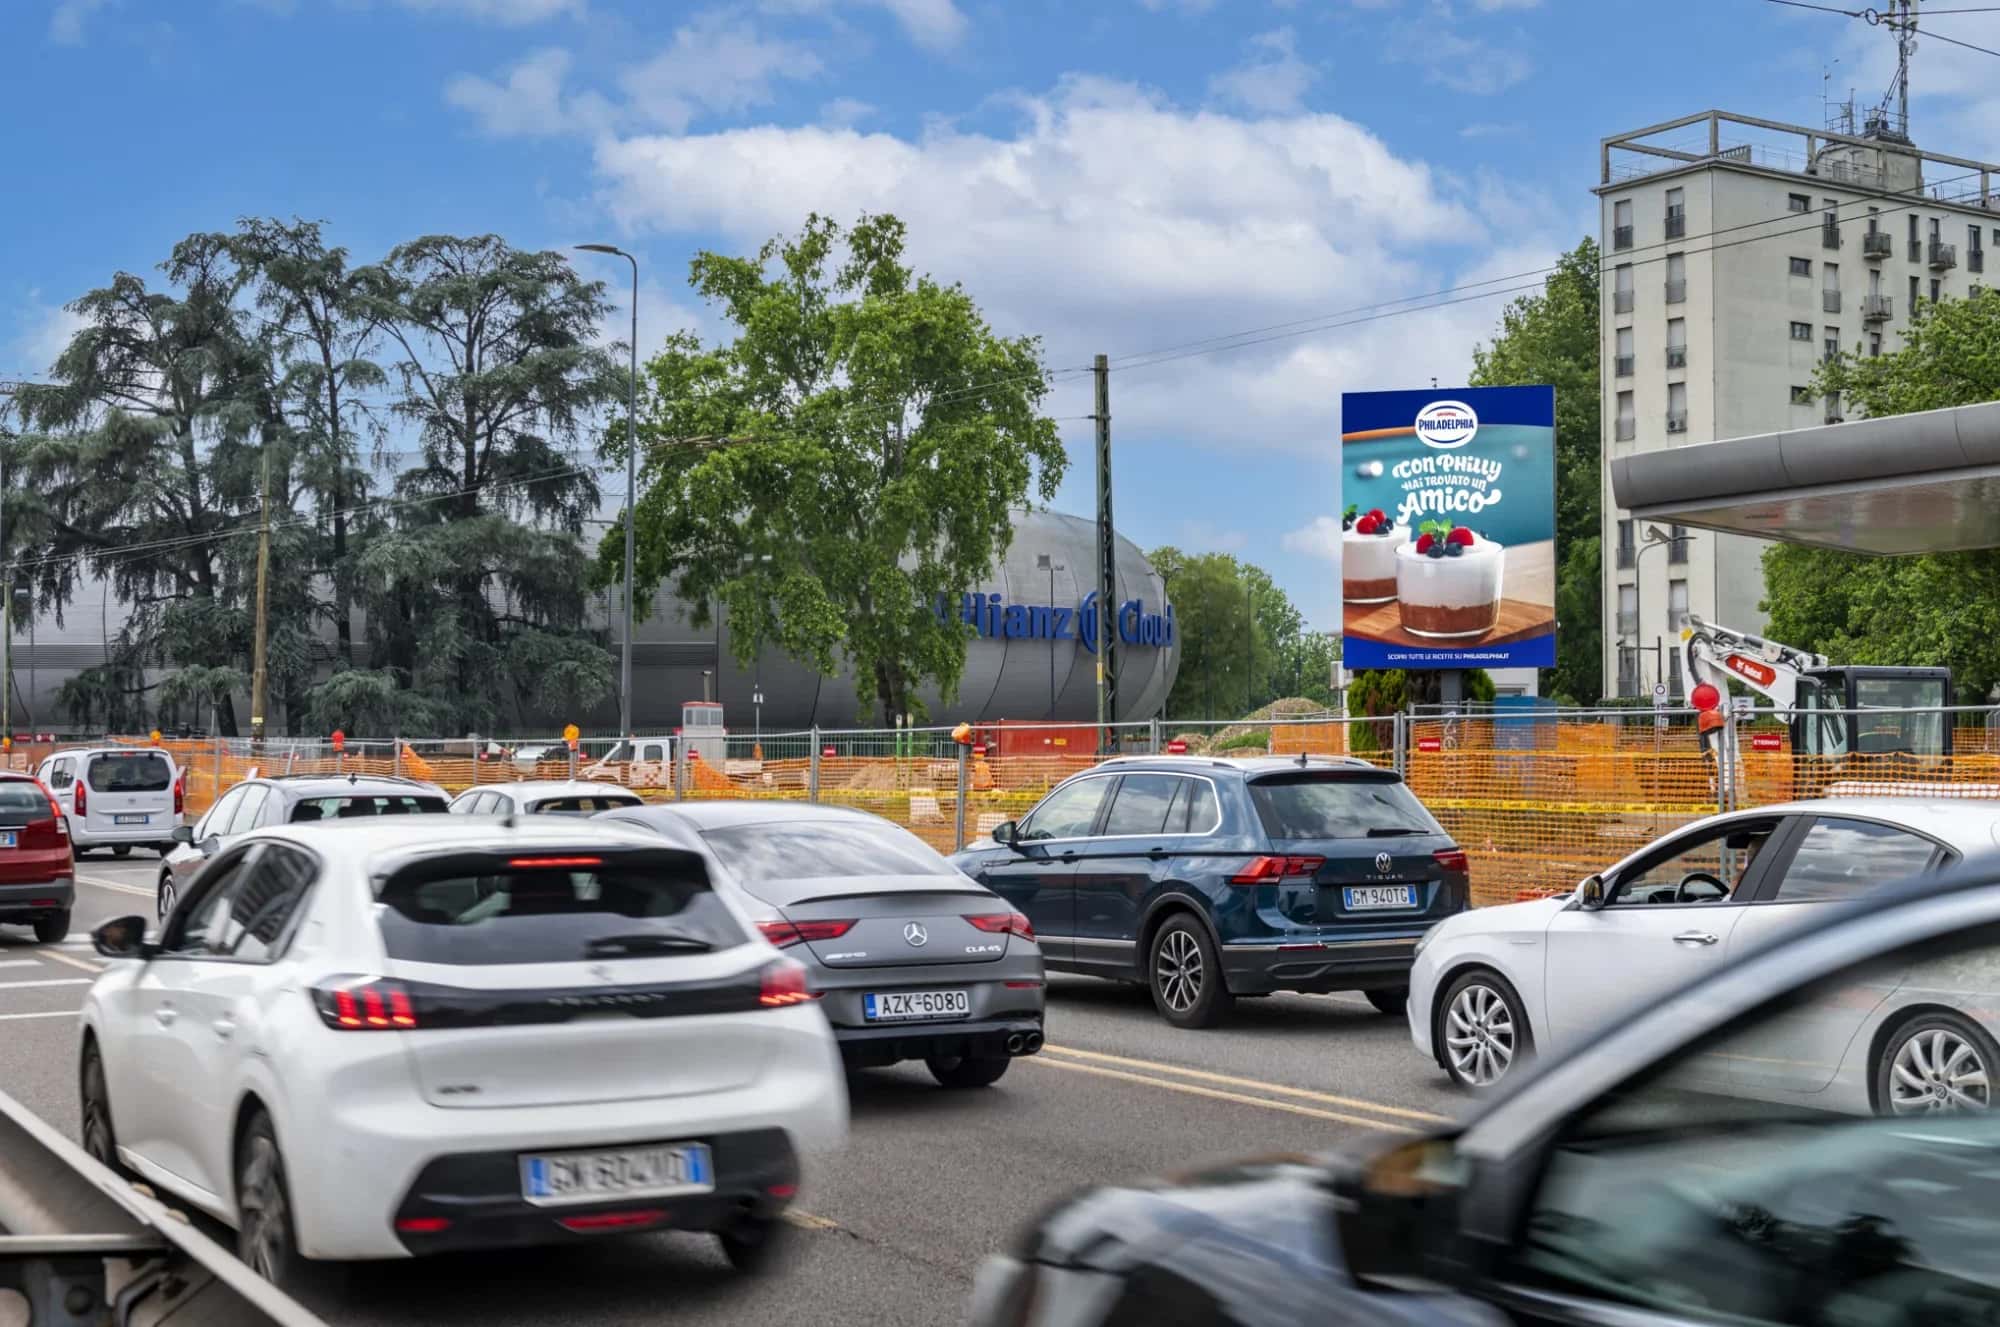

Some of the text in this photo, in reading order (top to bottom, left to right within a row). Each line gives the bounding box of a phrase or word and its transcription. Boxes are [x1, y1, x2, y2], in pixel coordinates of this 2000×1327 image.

[1418, 418, 1475, 431] PHILADELPHIA
[1423, 475, 1470, 487] TROVATO
[1119, 599, 1174, 647] Cloud
[1352, 887, 1408, 905] GM 940TG
[965, 944, 1001, 953] CLA 45
[882, 992, 966, 1015] AZK-6080
